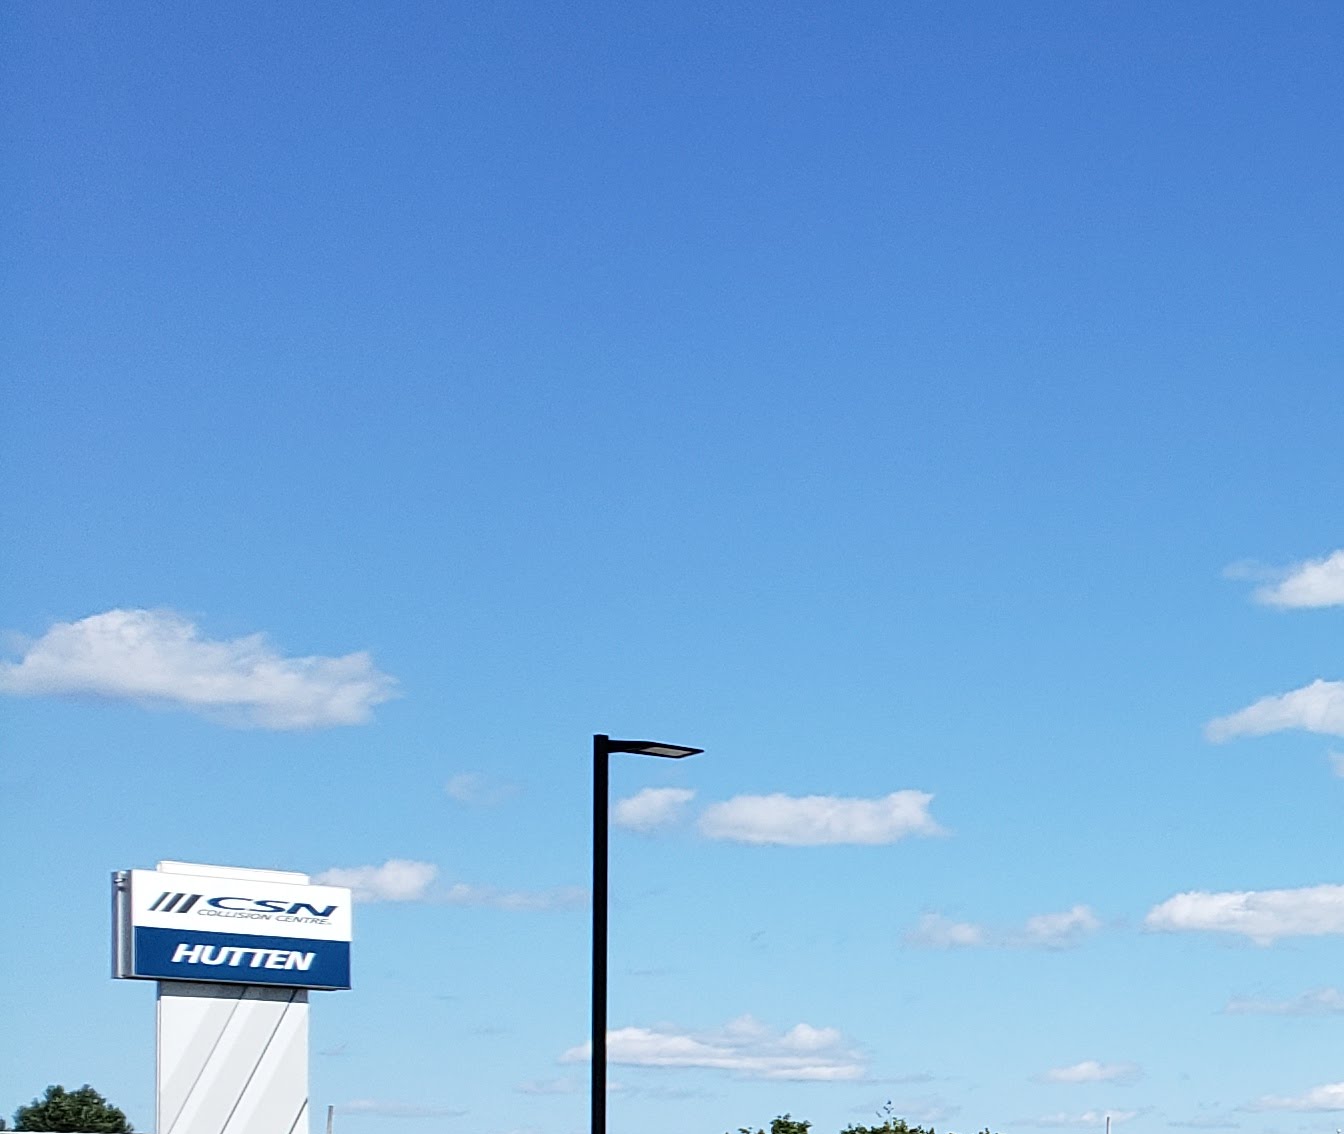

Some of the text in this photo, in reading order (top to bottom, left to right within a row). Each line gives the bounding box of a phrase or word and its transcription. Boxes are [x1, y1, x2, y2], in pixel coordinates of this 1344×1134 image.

[197, 909, 329, 925] COLLISION CENTRE
[207, 897, 338, 917] CSN
[171, 943, 316, 970] HUTTEN
